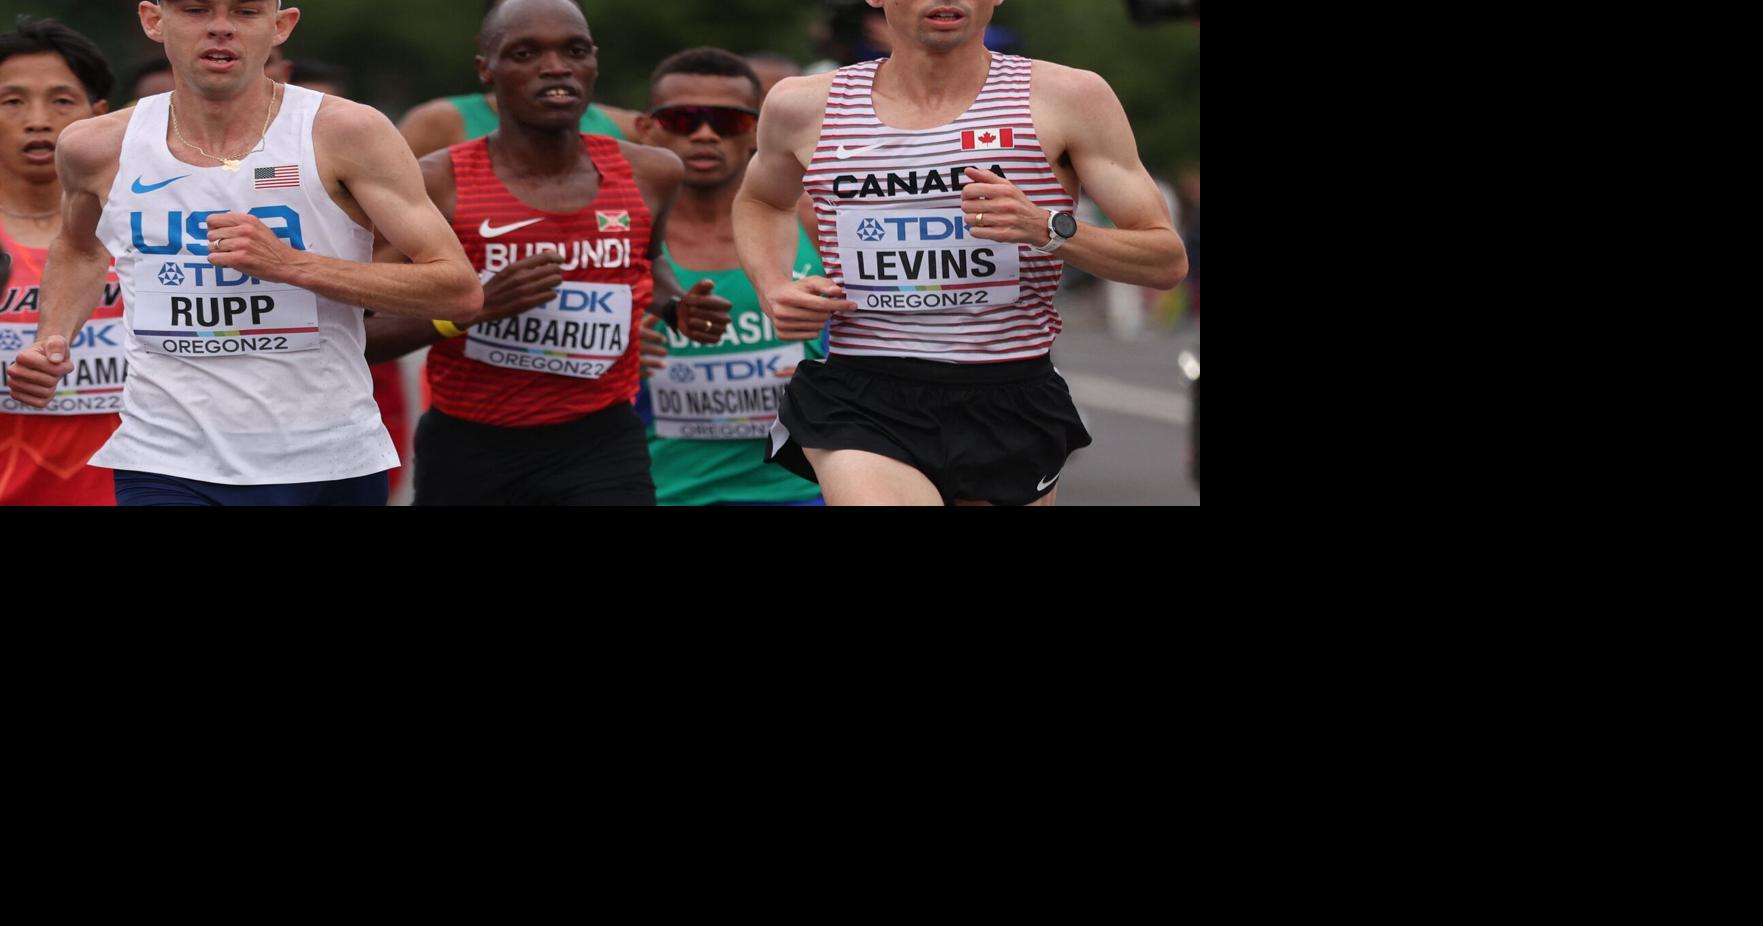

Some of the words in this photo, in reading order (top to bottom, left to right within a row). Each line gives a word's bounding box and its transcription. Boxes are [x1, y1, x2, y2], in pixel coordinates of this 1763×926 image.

[184, 262, 260, 287] TD
[857, 248, 996, 280] LEVINS
[171, 295, 275, 327] RUPP
[867, 291, 988, 309] OREGON22
[162, 337, 288, 354] OREGON22
[489, 350, 605, 376] OREGON22
[695, 355, 781, 382] TDK
[658, 389, 682, 413] DO
